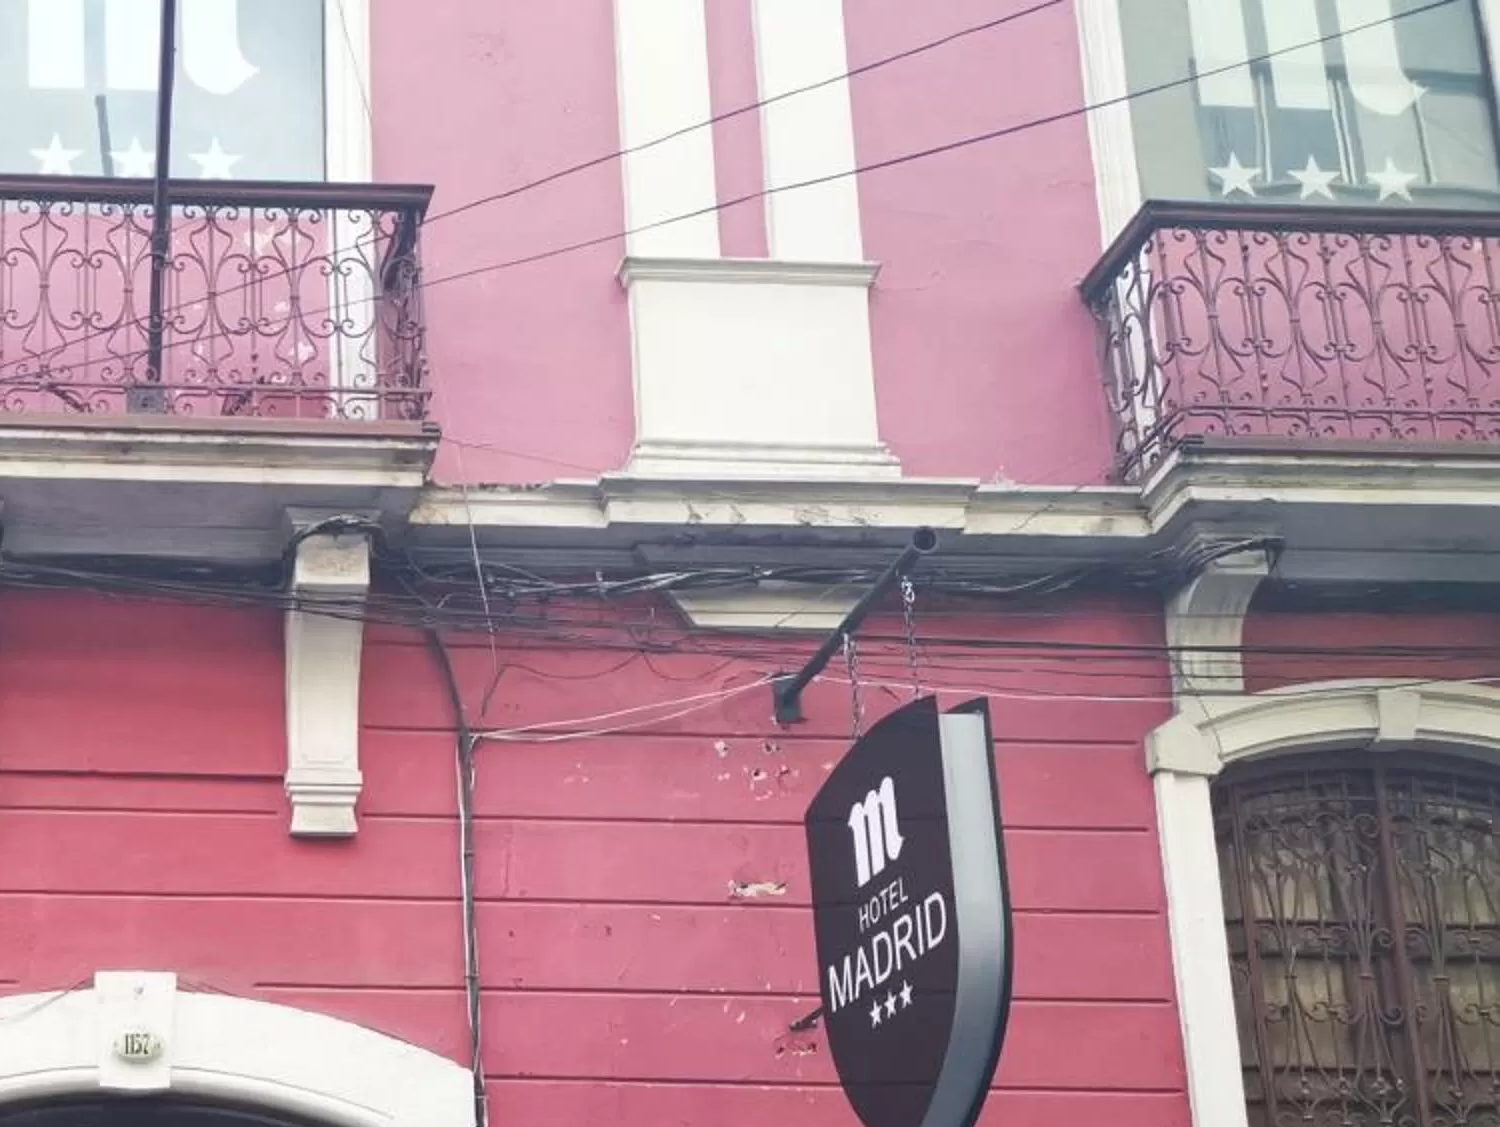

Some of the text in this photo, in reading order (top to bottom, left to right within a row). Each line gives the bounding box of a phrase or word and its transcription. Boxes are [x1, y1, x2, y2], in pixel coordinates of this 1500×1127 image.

[847, 775, 905, 888] m
[828, 891, 947, 1013] MADRID
[858, 877, 909, 932] HOTEL
